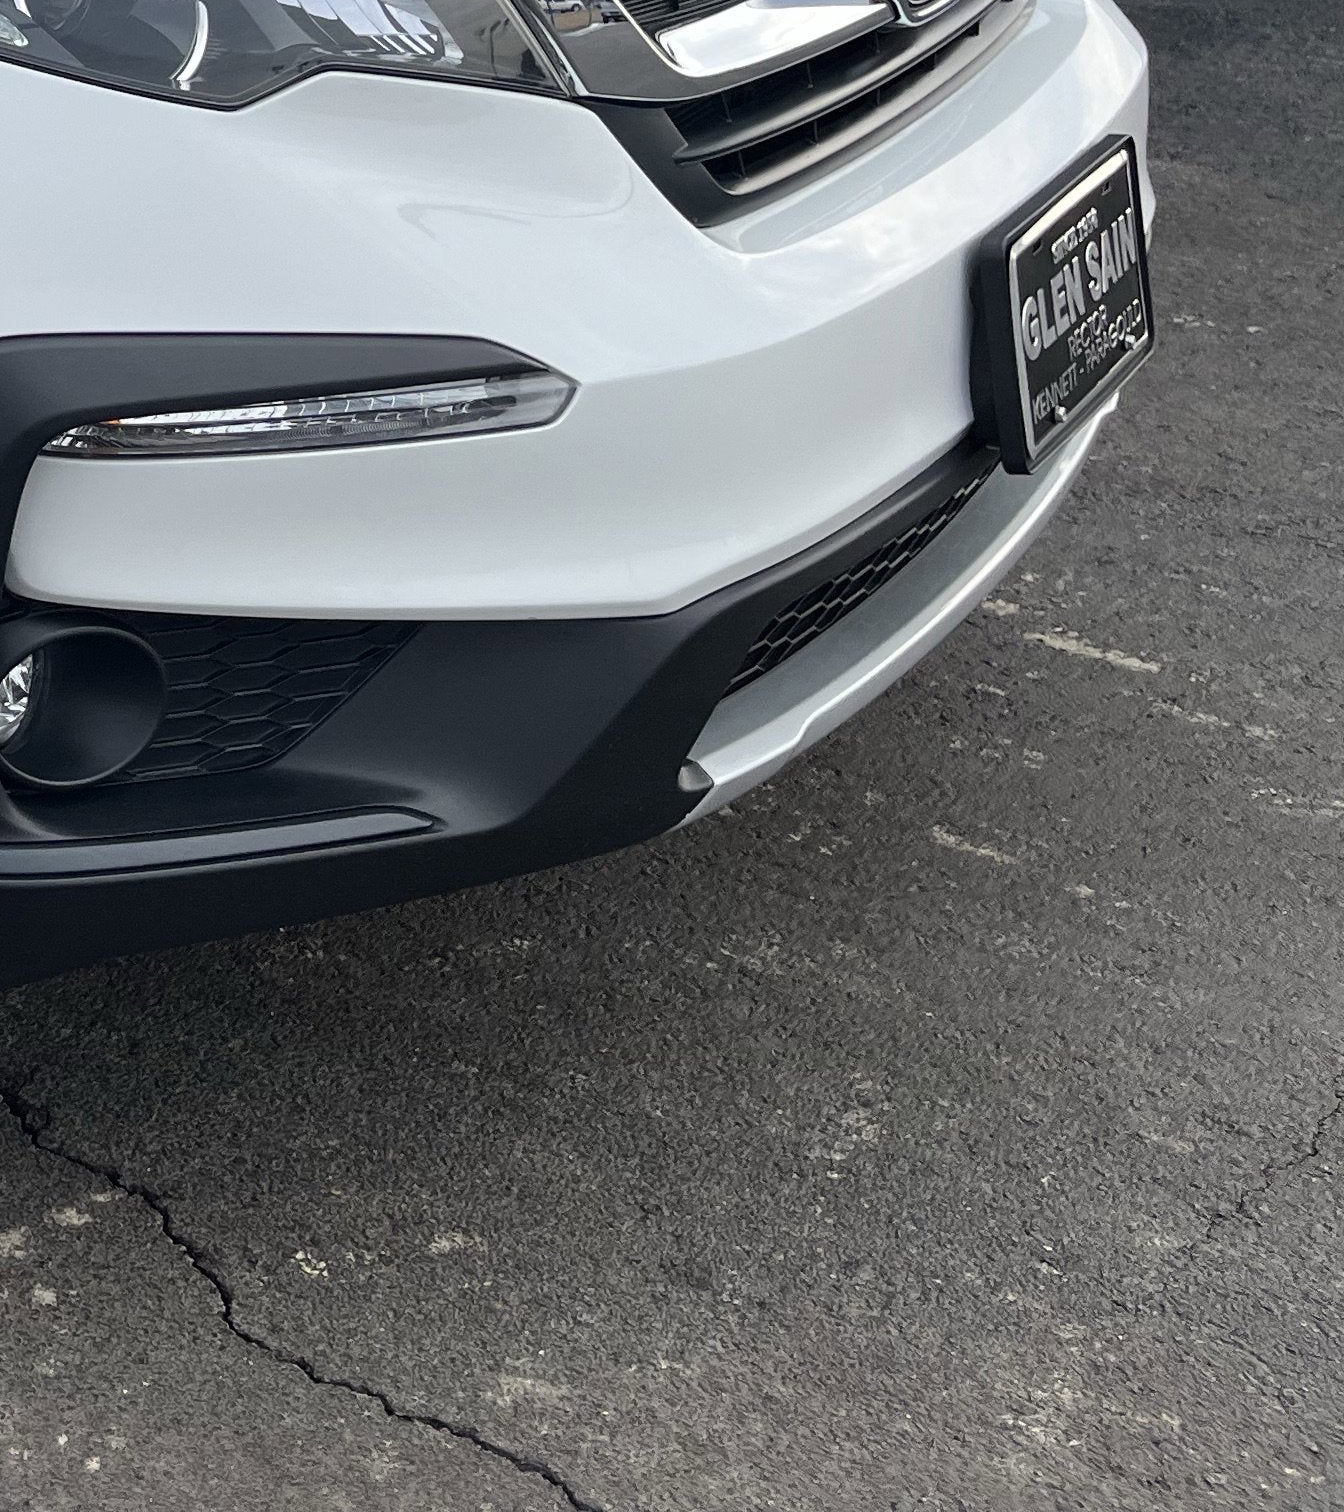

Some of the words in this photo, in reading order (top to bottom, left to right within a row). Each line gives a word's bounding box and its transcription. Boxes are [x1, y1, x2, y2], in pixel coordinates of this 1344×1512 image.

[1021, 256, 1086, 361] GLEN
[1085, 207, 1137, 302] SAIN
[1068, 304, 1108, 361] RECTOR
[1032, 362, 1078, 425] KENNETT
[1084, 298, 1142, 375] PARAGOULD
